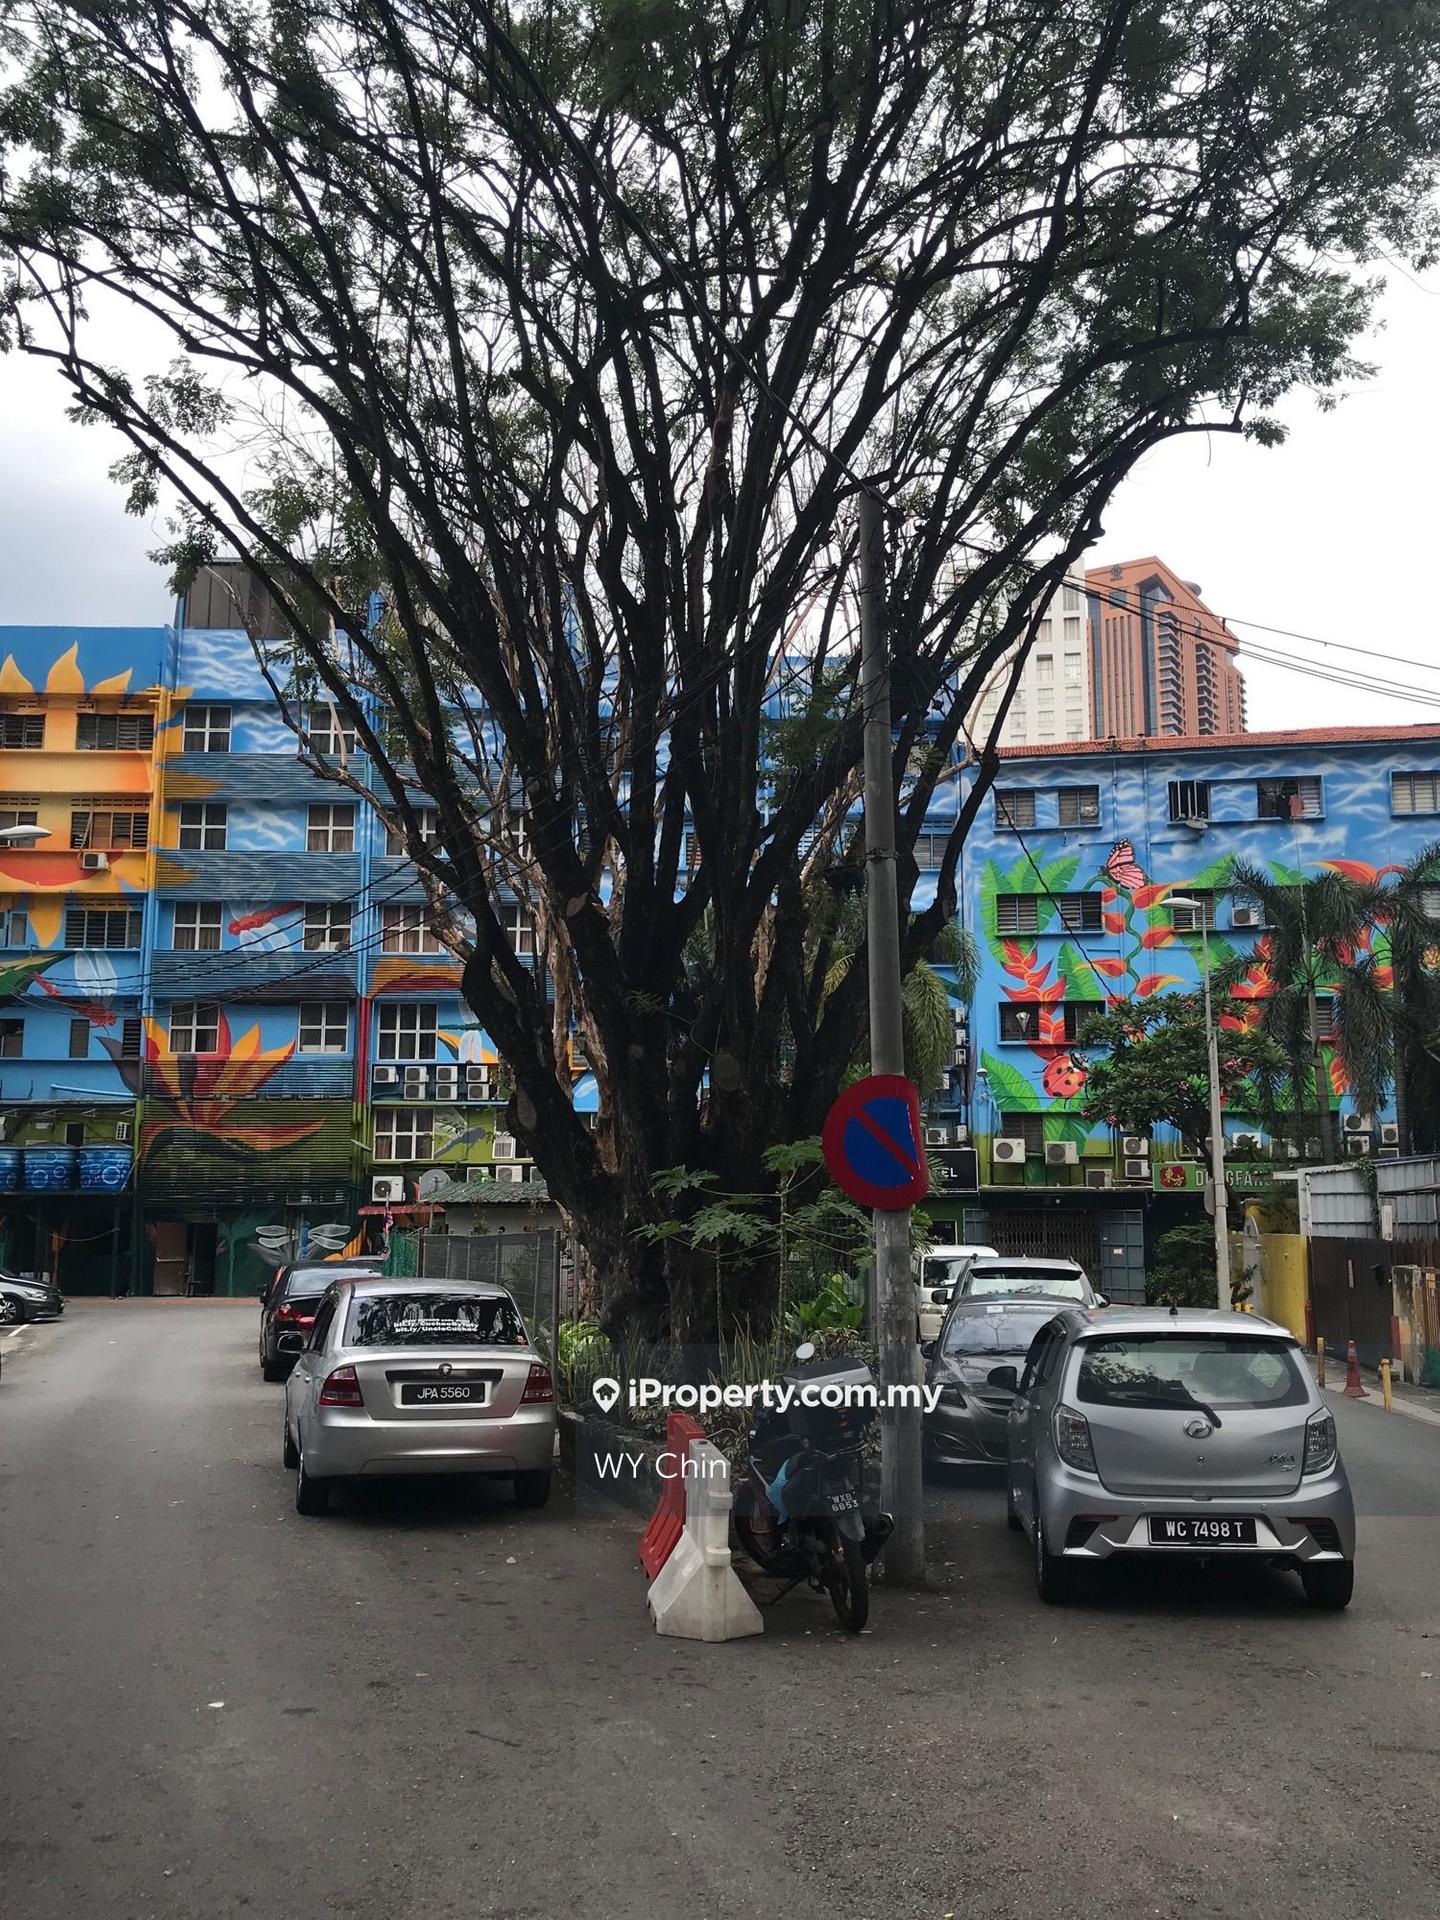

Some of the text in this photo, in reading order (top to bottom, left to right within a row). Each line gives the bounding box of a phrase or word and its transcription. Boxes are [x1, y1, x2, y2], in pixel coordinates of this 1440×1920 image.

[1164, 1167, 1185, 1187] 東方
[417, 1387, 470, 1399] JPA 5560
[1165, 1521, 1243, 1538] WC 7498 T
